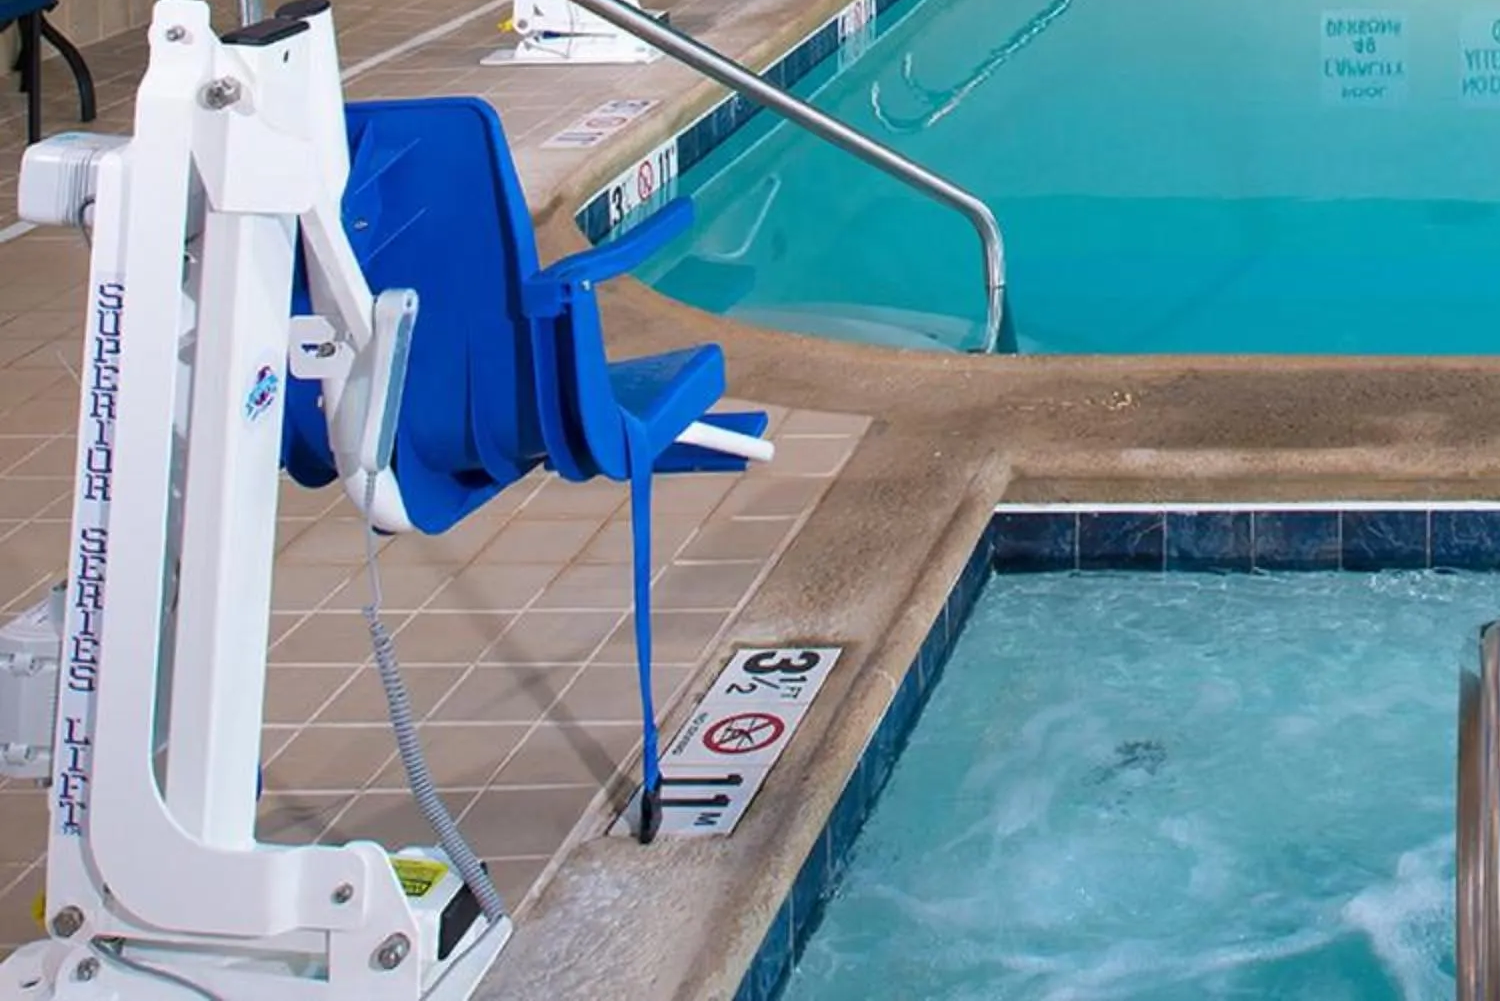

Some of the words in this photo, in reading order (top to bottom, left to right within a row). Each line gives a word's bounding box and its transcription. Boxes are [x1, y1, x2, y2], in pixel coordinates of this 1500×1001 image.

[84, 283, 125, 502] SUPERIOR
[68, 527, 108, 692] SERIES
[743, 651, 821, 675] 3
[59, 717, 87, 826] LIFT
[694, 812, 722, 826] M
